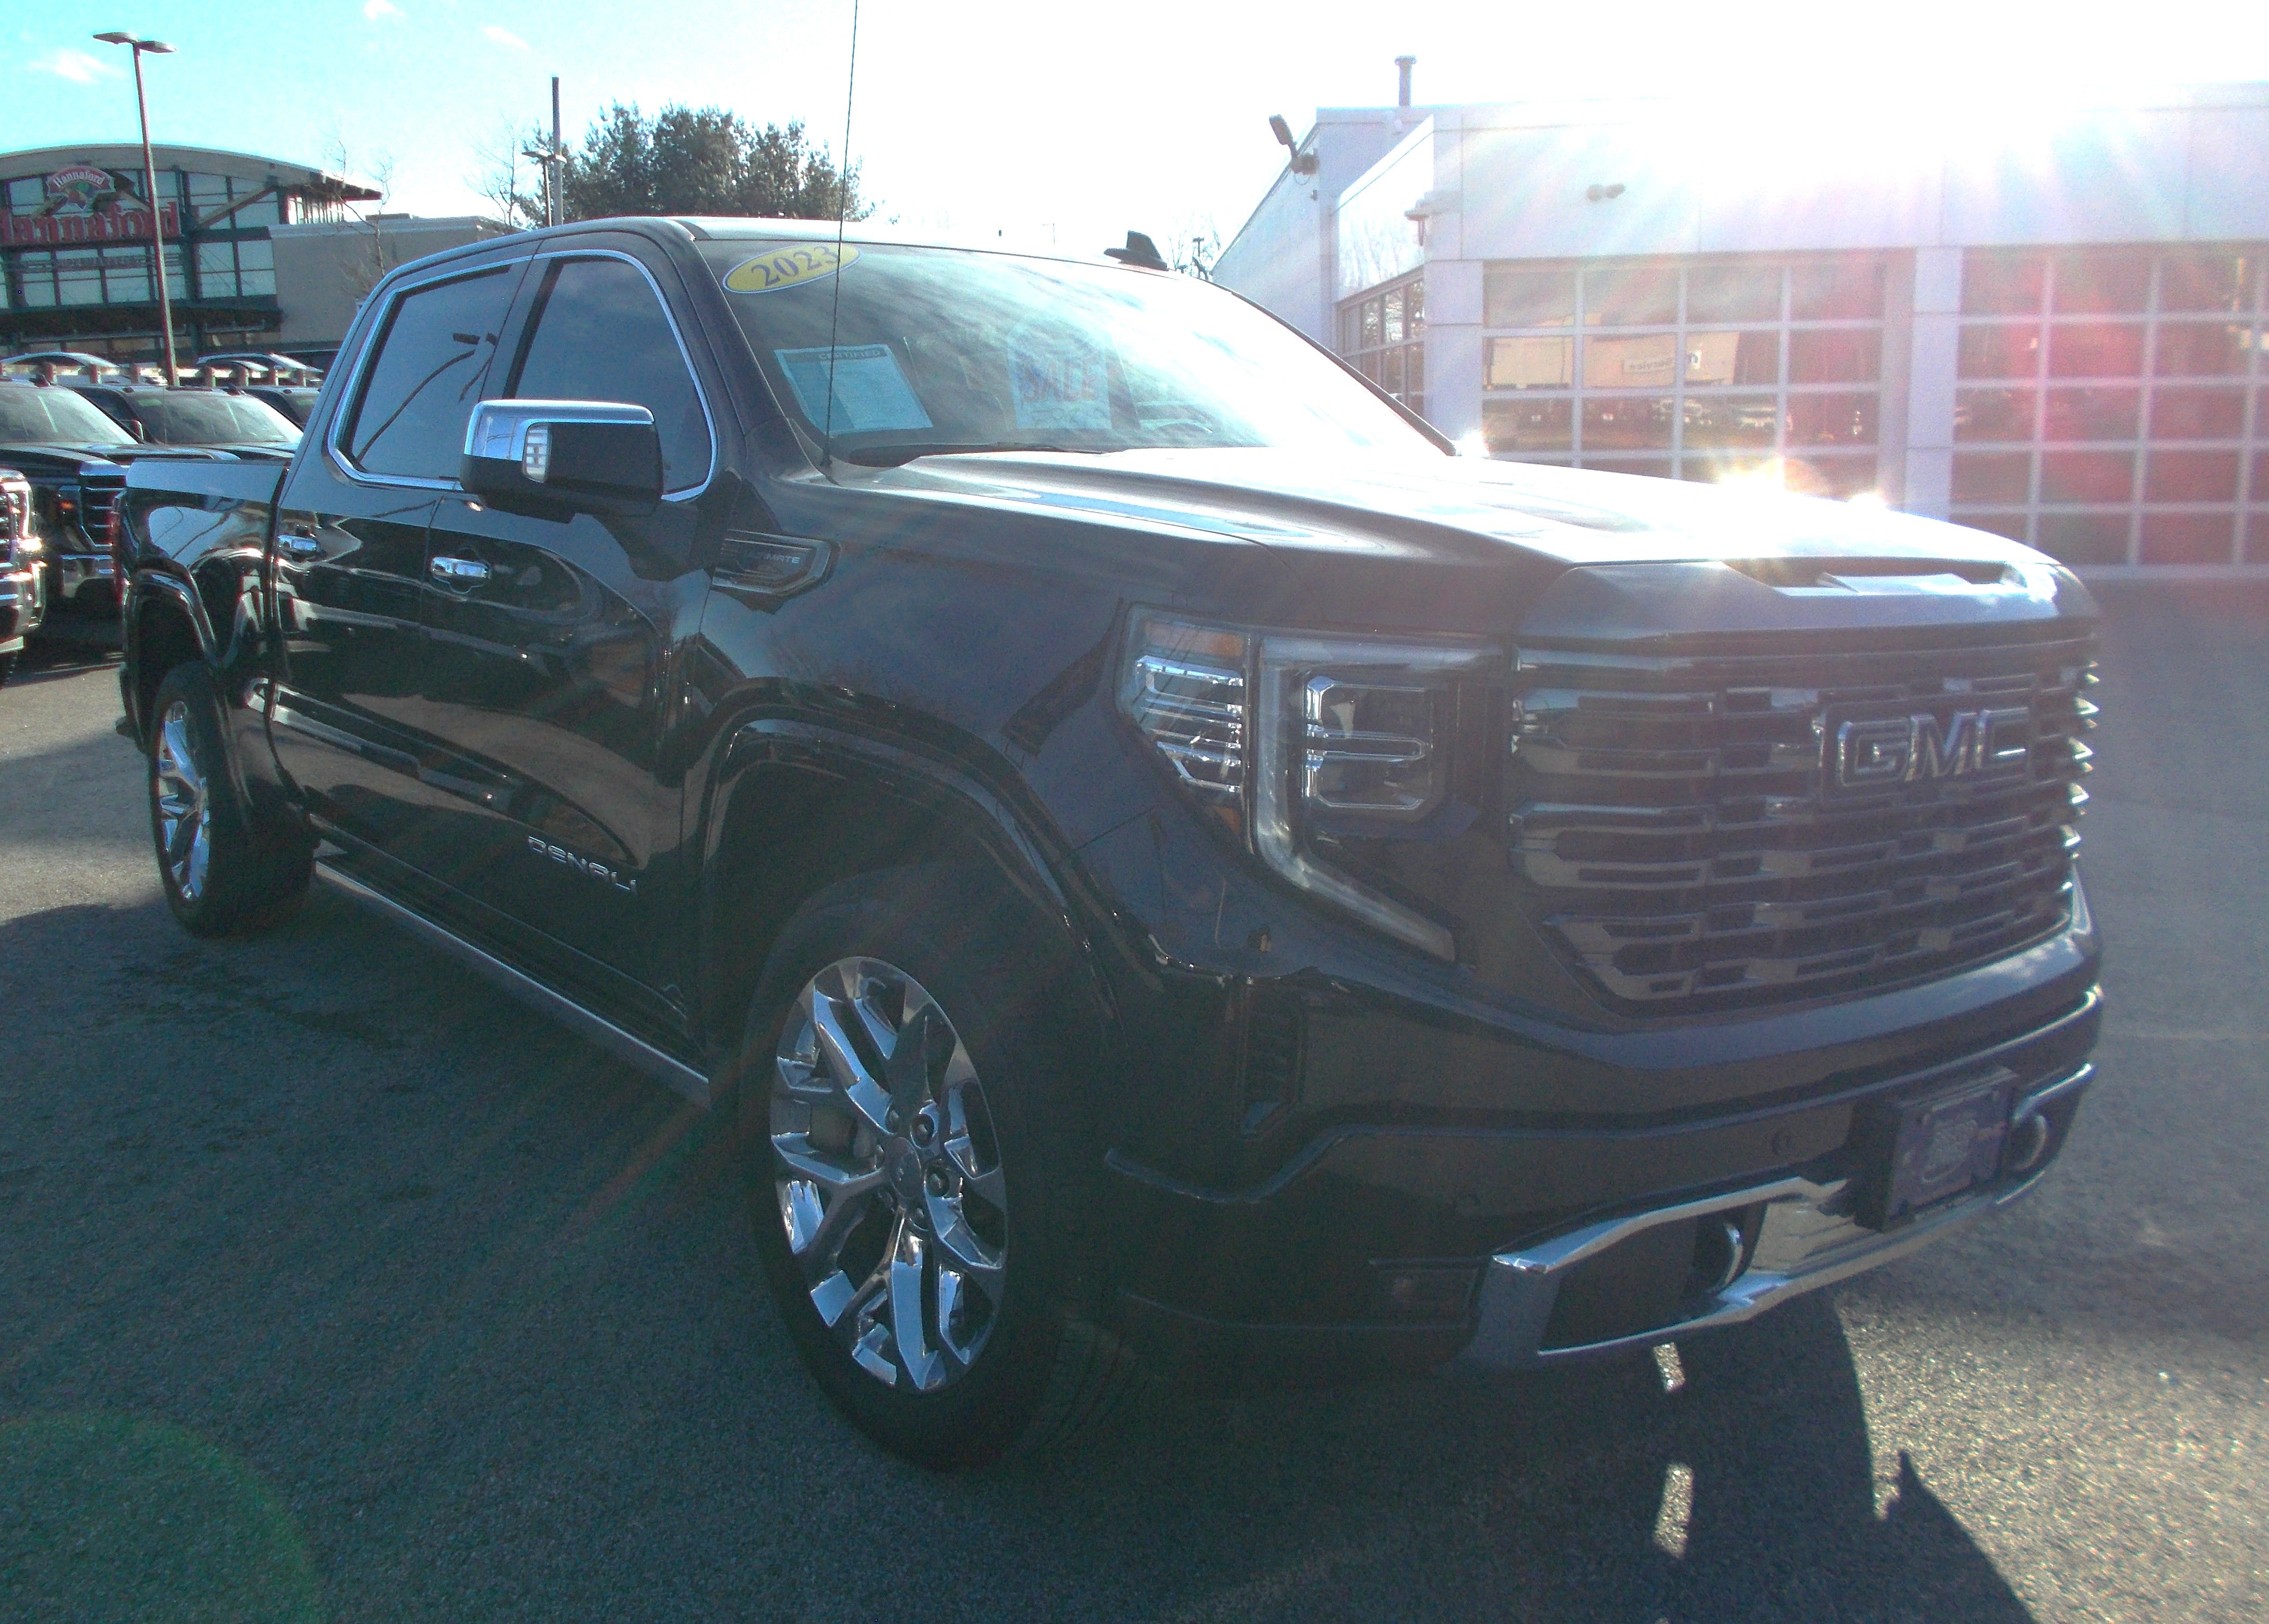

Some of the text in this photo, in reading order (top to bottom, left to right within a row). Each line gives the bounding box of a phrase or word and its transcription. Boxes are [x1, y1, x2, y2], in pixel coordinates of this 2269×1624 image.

[53, 170, 106, 187] Hannaford
[751, 245, 839, 287] 2023
[818, 350, 880, 359] CERTIFIED
[1838, 706, 2029, 787] GMC
[528, 836, 637, 894] DENALI
